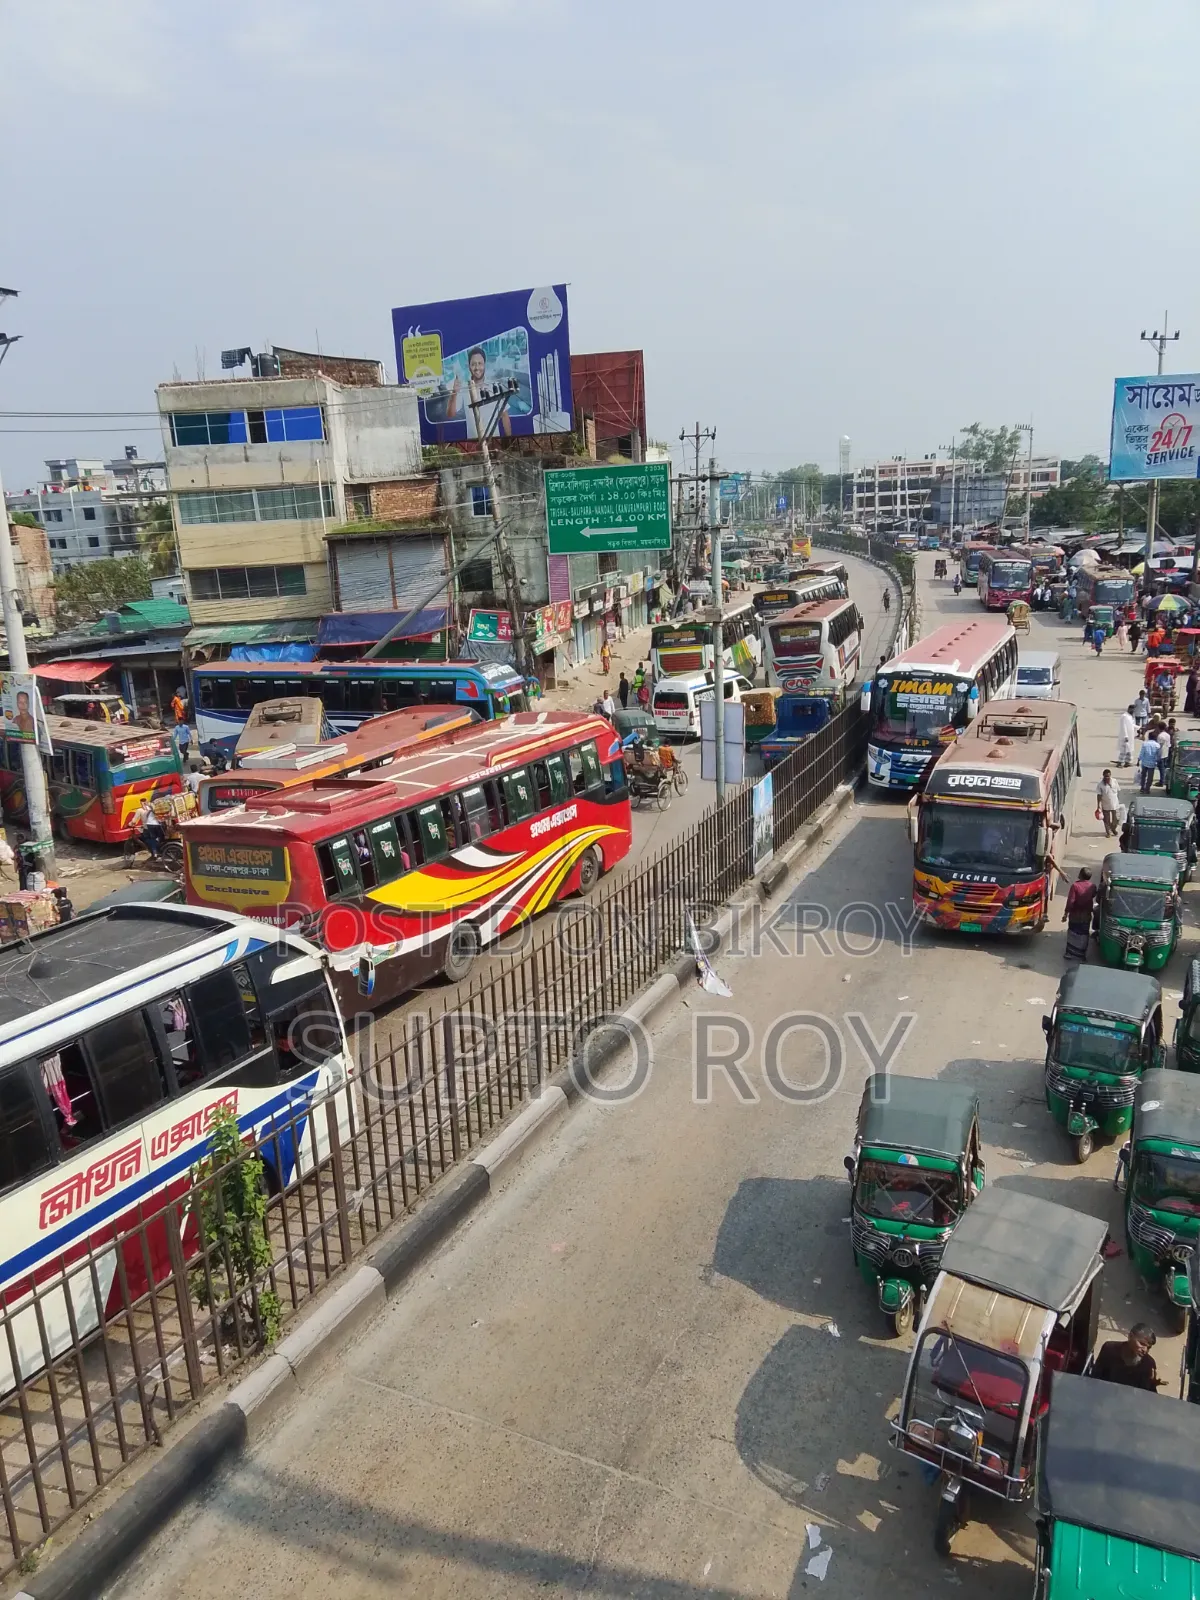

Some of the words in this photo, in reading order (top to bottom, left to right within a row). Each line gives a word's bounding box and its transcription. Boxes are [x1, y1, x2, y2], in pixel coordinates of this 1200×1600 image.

[1125, 382, 1195, 409] সায়েম
[1124, 425, 1150, 433] একের
[1125, 433, 1148, 444] ভিতর
[1149, 425, 1193, 453] 24/7
[1135, 443, 1148, 452] সব
[1145, 446, 1196, 465] SERVICE
[650, 474, 665, 487] সড়ক
[550, 495, 577, 506] সড়কের
[653, 501, 666, 512] ROAD
[550, 517, 599, 526] LENGTH
[648, 513, 667, 521] KM
[197, 845, 226, 861] প্রথমা
[226, 848, 274, 866] এক্সপ্রেস
[952, 872, 997, 883] EICHER
[205, 884, 270, 896] Exclusive
[39, 1138, 142, 1230] সৌখিন
